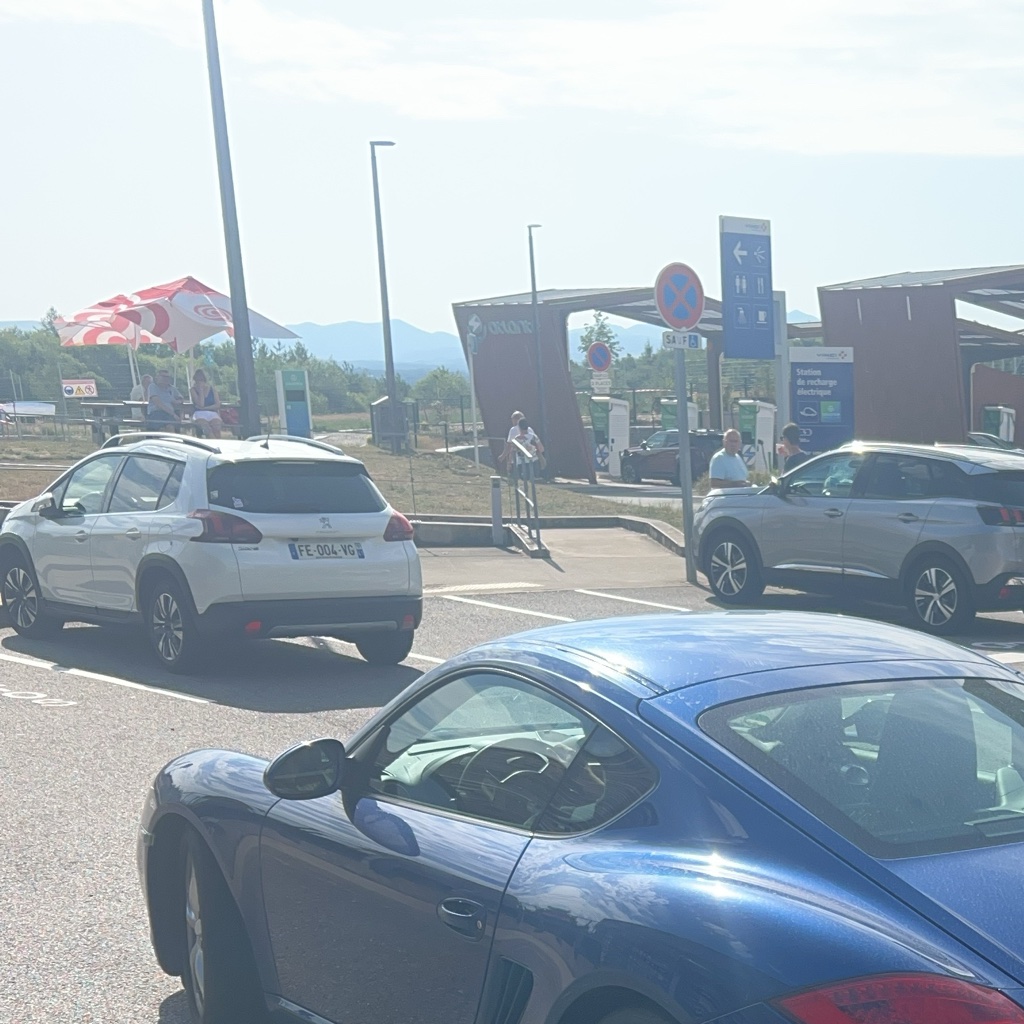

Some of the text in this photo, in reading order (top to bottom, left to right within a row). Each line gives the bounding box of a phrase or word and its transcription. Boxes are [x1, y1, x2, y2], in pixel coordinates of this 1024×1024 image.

[796, 368, 822, 376] Station
[797, 378, 838, 388] de recharge
[797, 387, 832, 397] électrique
[298, 544, 355, 556] FE-004-VG
